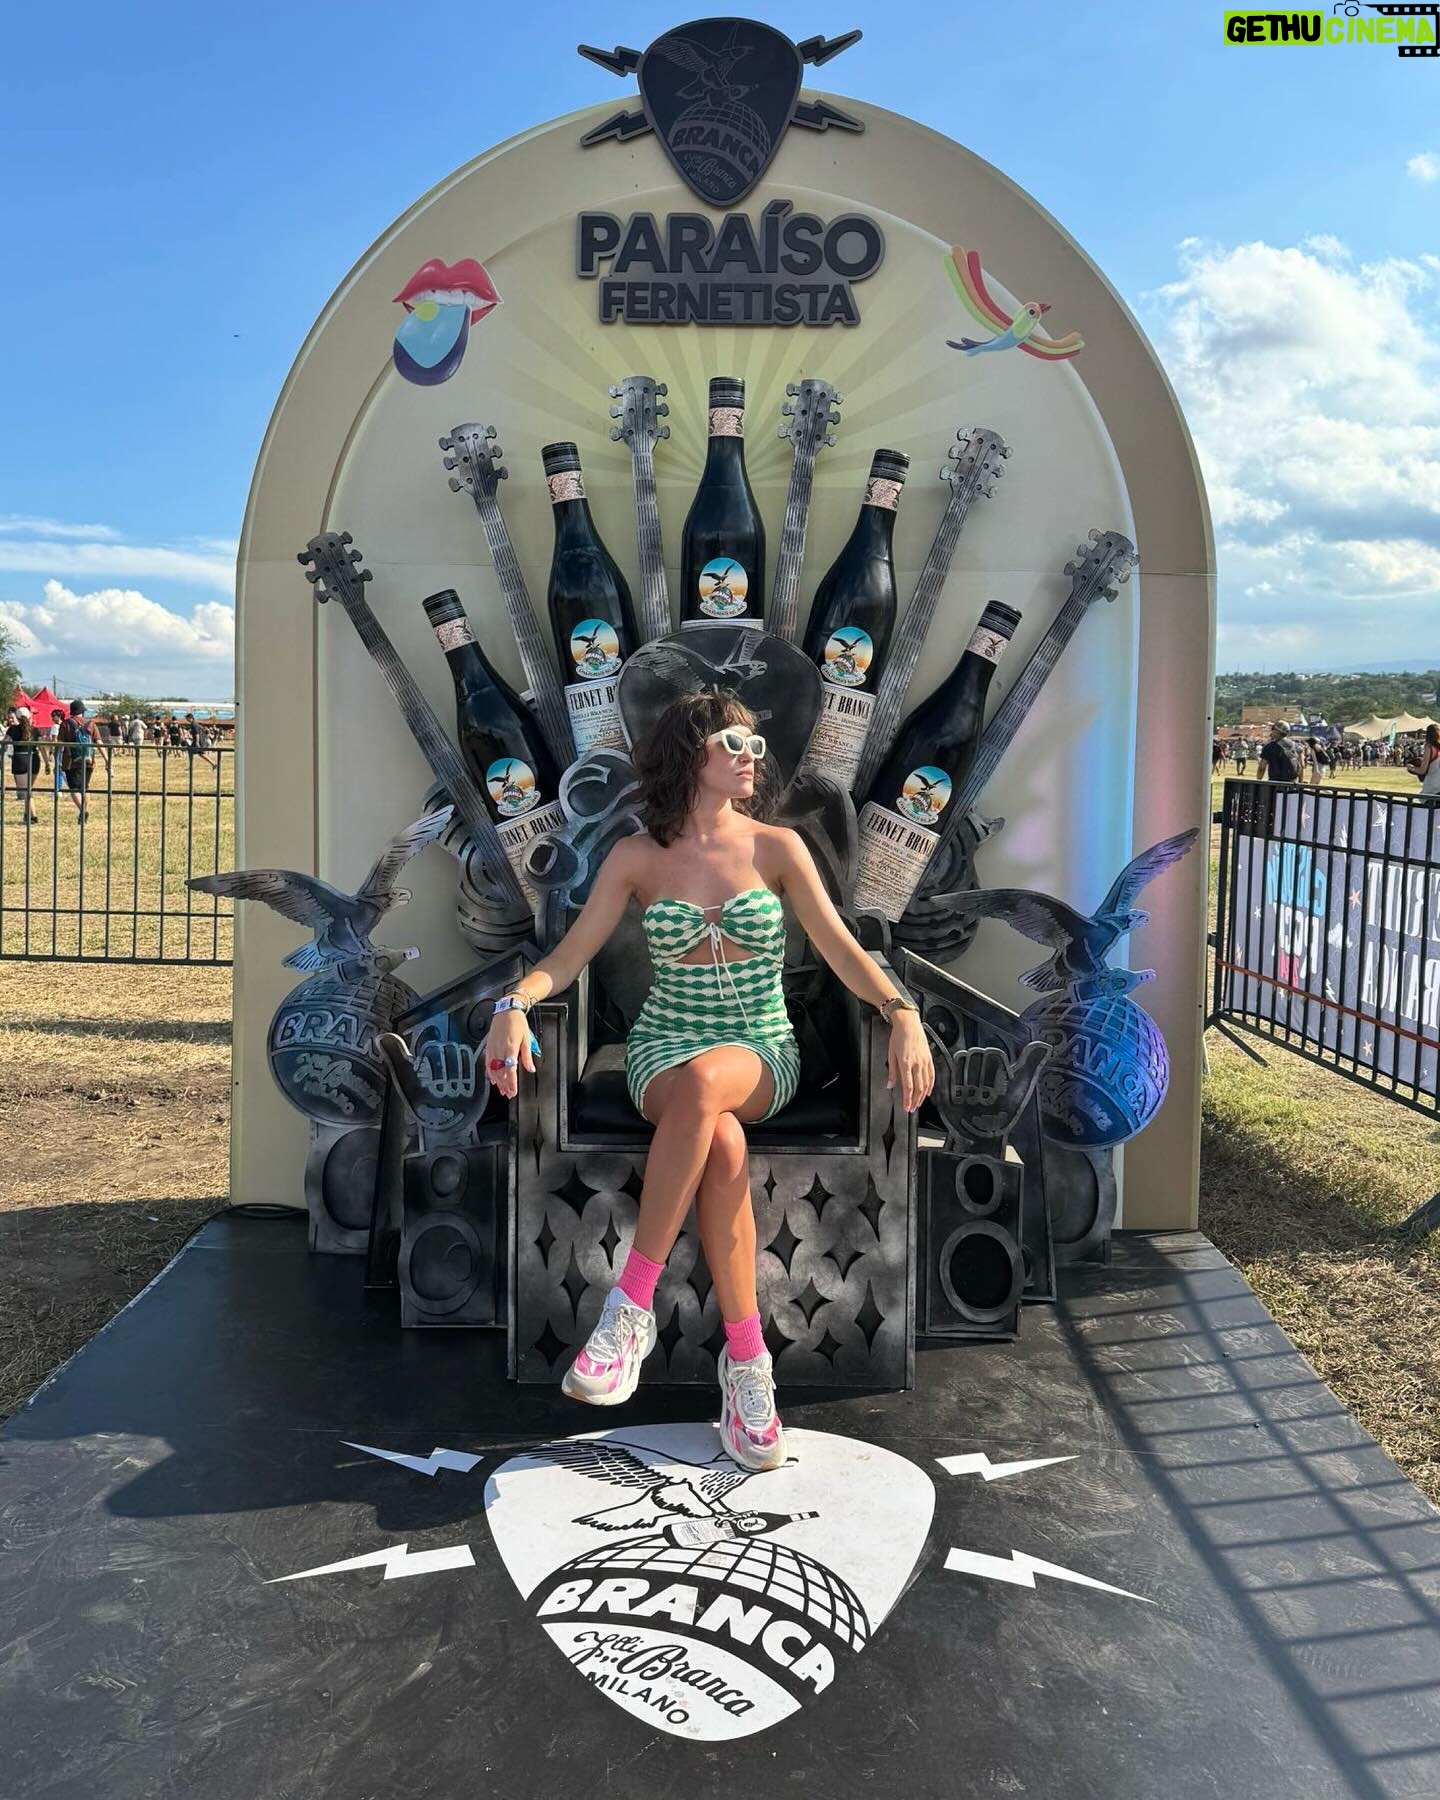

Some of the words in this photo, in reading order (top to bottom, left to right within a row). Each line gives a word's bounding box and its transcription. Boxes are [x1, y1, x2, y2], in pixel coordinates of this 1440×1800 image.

[579, 201, 882, 277] PARAÍSO
[601, 281, 857, 321] FERNETISTA
[866, 812, 907, 843] FERNET
[277, 1010, 384, 1064] BRAN
[536, 1577, 835, 1695] BRANCA
[586, 1671, 690, 1724] MILANO
[616, 1644, 756, 1718] Branca
